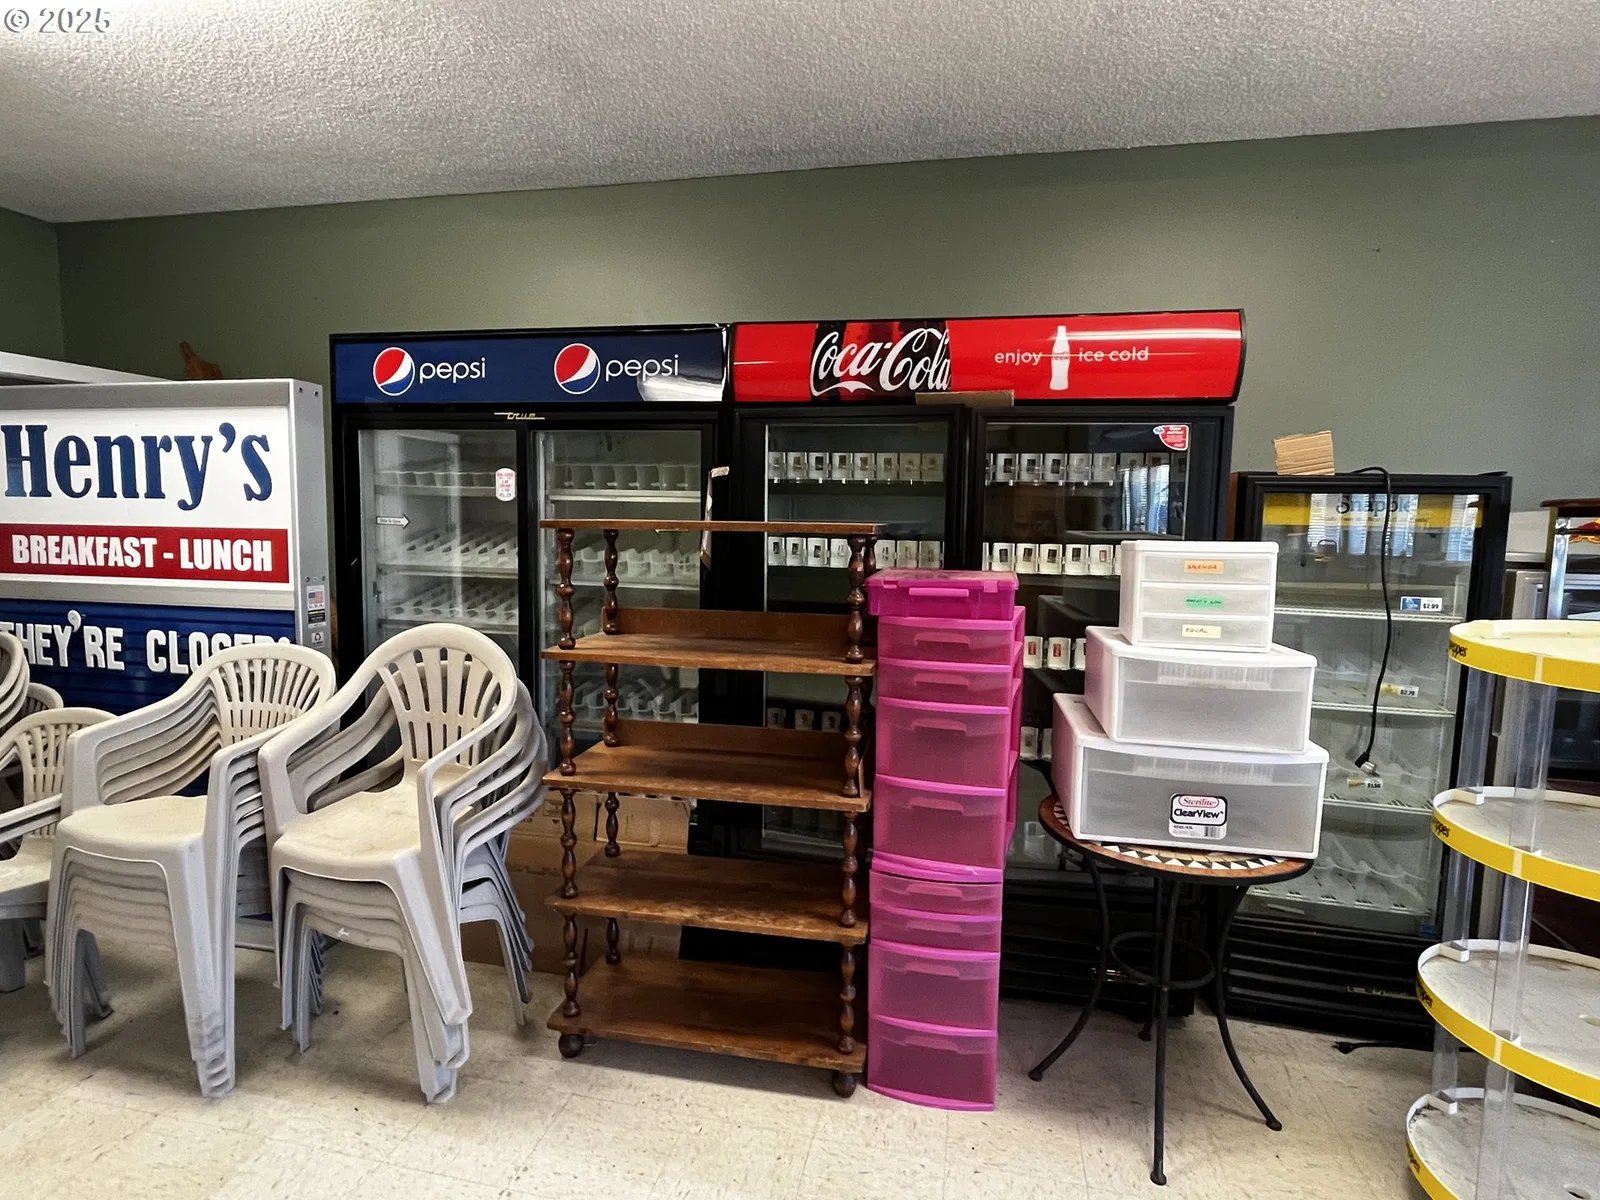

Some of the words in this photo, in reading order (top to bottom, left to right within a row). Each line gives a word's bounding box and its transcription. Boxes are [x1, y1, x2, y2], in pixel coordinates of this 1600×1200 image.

[605, 354, 679, 382] pepsi
[810, 327, 951, 396] Coca-Cola
[994, 349, 1042, 366] enjoy
[1078, 347, 1105, 362] ice
[1109, 346, 1149, 362] cold
[419, 357, 486, 384] pepsi
[1, 422, 273, 511] Henry's
[12, 534, 157, 568] BREAKFAST
[180, 538, 273, 572] LUNCH
[1173, 808, 1220, 819] ClearView
[1183, 796, 1213, 807] Sterilite
